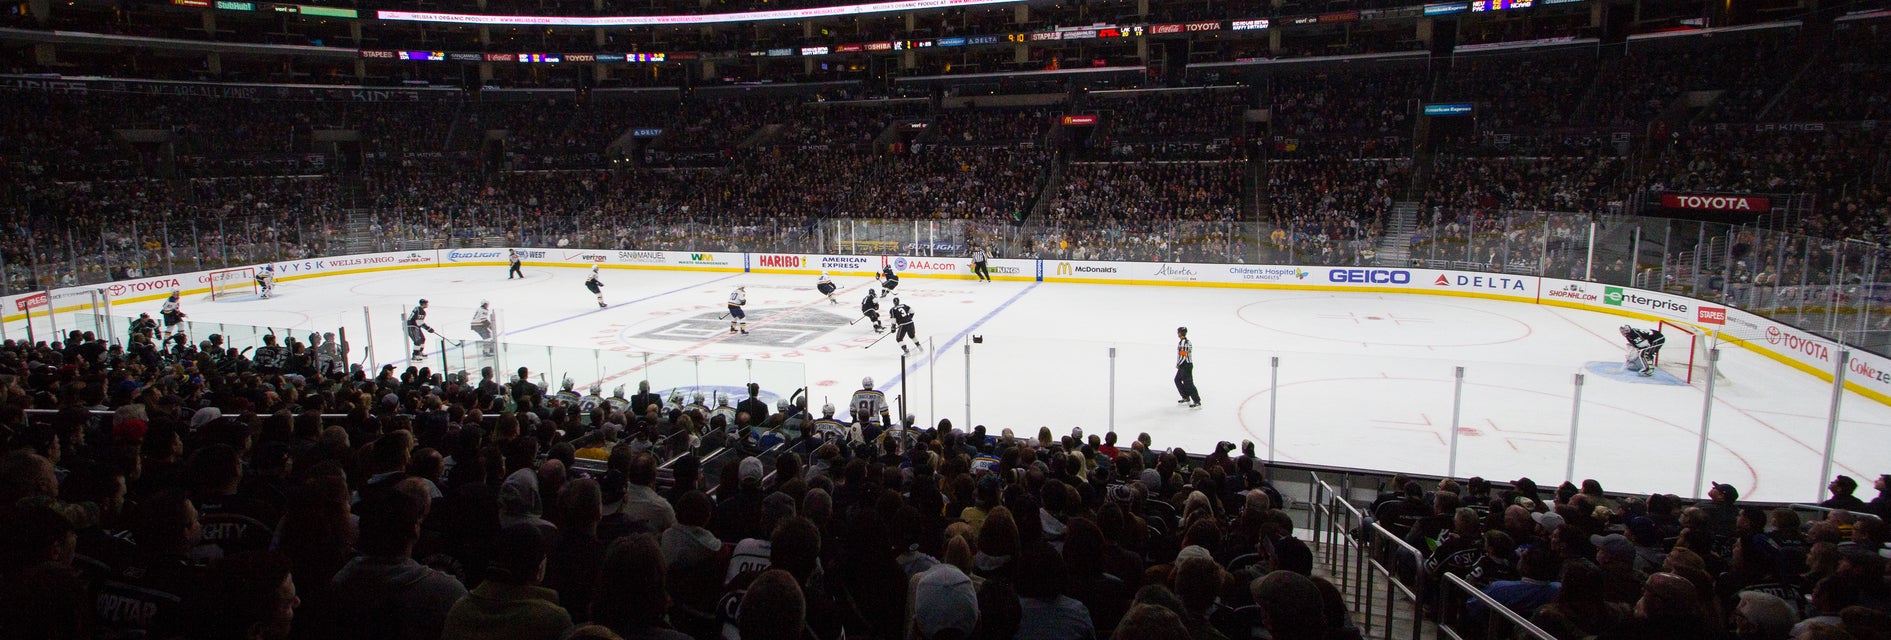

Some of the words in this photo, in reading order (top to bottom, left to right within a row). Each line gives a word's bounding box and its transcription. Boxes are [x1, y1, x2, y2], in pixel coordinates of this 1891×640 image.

[1296, 16, 1317, 24] verion
[1186, 22, 1221, 31] TOYOTA
[864, 42, 892, 50] TOSHIBA
[975, 37, 998, 45] DELTA
[363, 50, 393, 58] STAPLES
[565, 54, 595, 62] TOYOTA
[1677, 196, 1750, 210] TOYOTA
[529, 251, 546, 259] WEST
[582, 253, 607, 262] verizon
[330, 258, 362, 267] WELLS
[363, 256, 395, 265] FARGO
[760, 255, 800, 268] HARIBO
[909, 261, 956, 271] AAA.com
[1075, 266, 1117, 274] McDonald's
[1154, 264, 1197, 276] Alberta
[1229, 267, 1263, 275] Children's
[1265, 268, 1296, 277] Hospital
[1328, 269, 1411, 284] GEICO
[128, 278, 180, 293] TOYOTA
[1457, 275, 1525, 291] DELTA
[1549, 289, 1598, 302] SHOP.NHL.COM
[1608, 291, 1688, 313] enterprise
[898, 307, 907, 318] 3
[1699, 311, 1724, 321] STAPLES
[1783, 332, 1829, 362] TOYOTA
[1850, 357, 1877, 379] Coke
